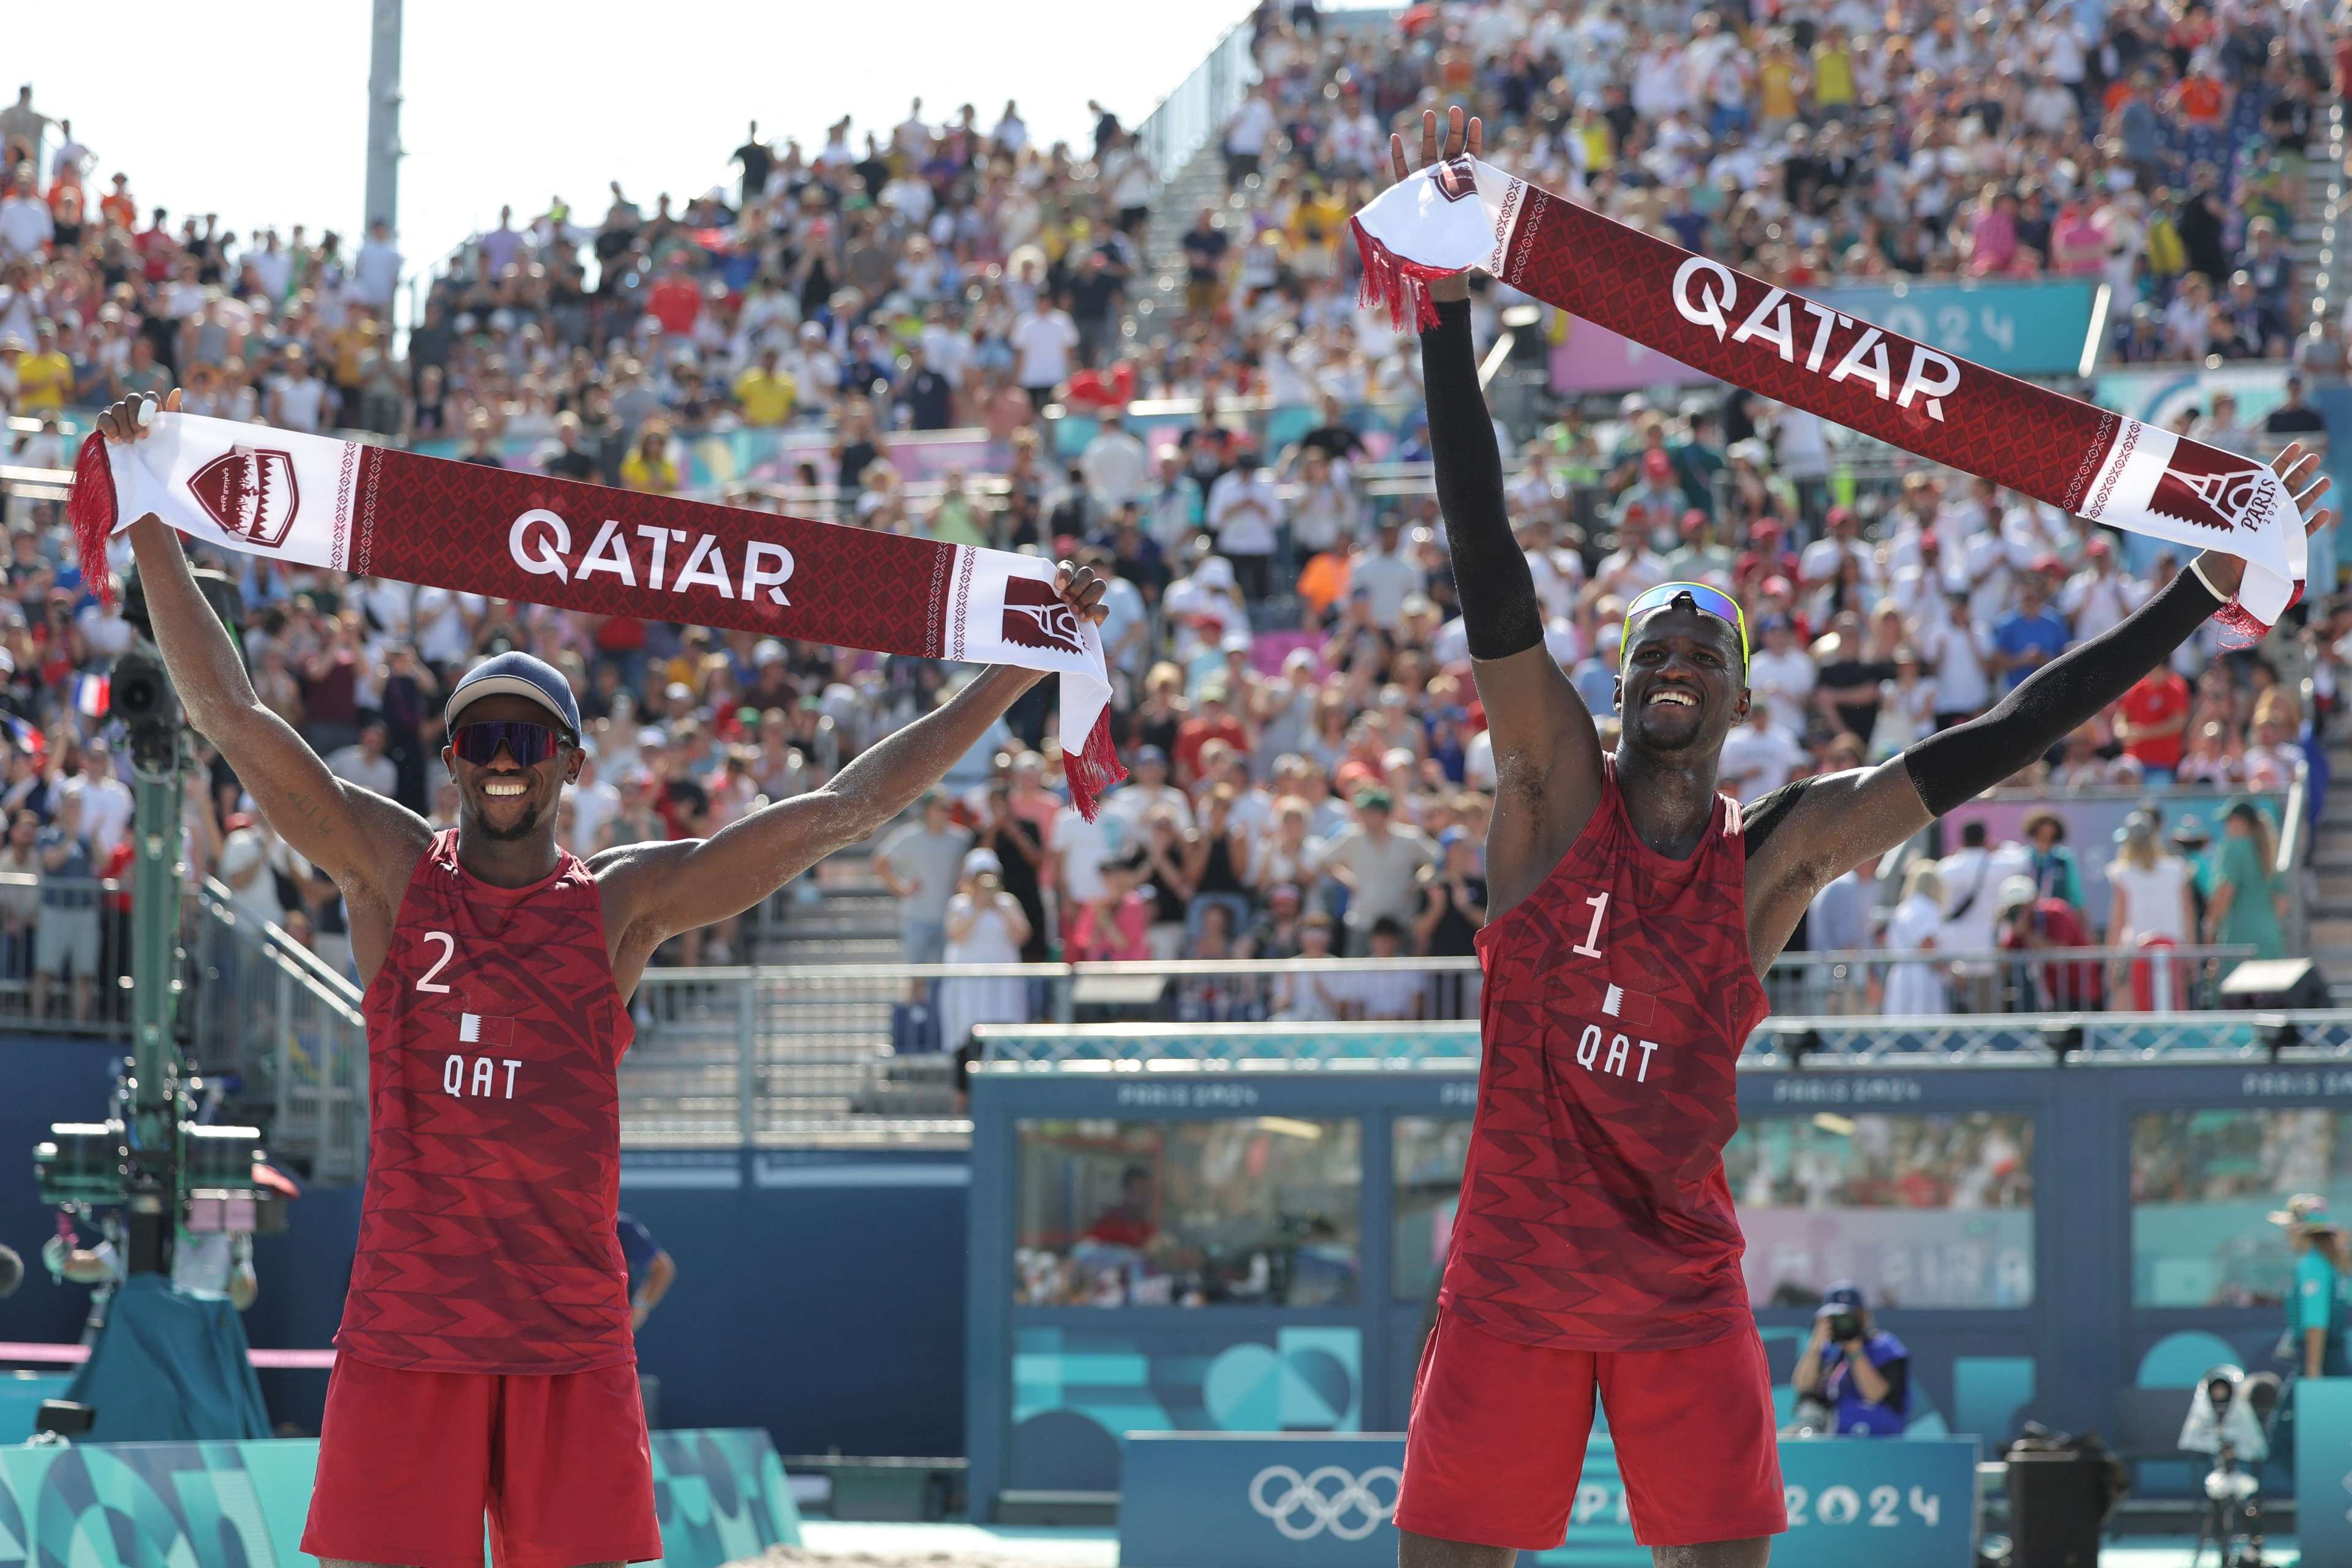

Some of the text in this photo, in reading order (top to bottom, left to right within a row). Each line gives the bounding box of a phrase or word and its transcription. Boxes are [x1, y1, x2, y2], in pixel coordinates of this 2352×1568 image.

[1673, 257, 1961, 423] QATAR
[2241, 479, 2276, 532] PARIS
[2263, 494, 2279, 524] 202
[509, 508, 794, 606] QATAR
[1572, 892, 1610, 959] 1
[416, 931, 454, 993] 2
[443, 1054, 522, 1099] QAT
[1577, 1024, 1659, 1083] QAT
[1784, 1485, 1940, 1526] 2024
